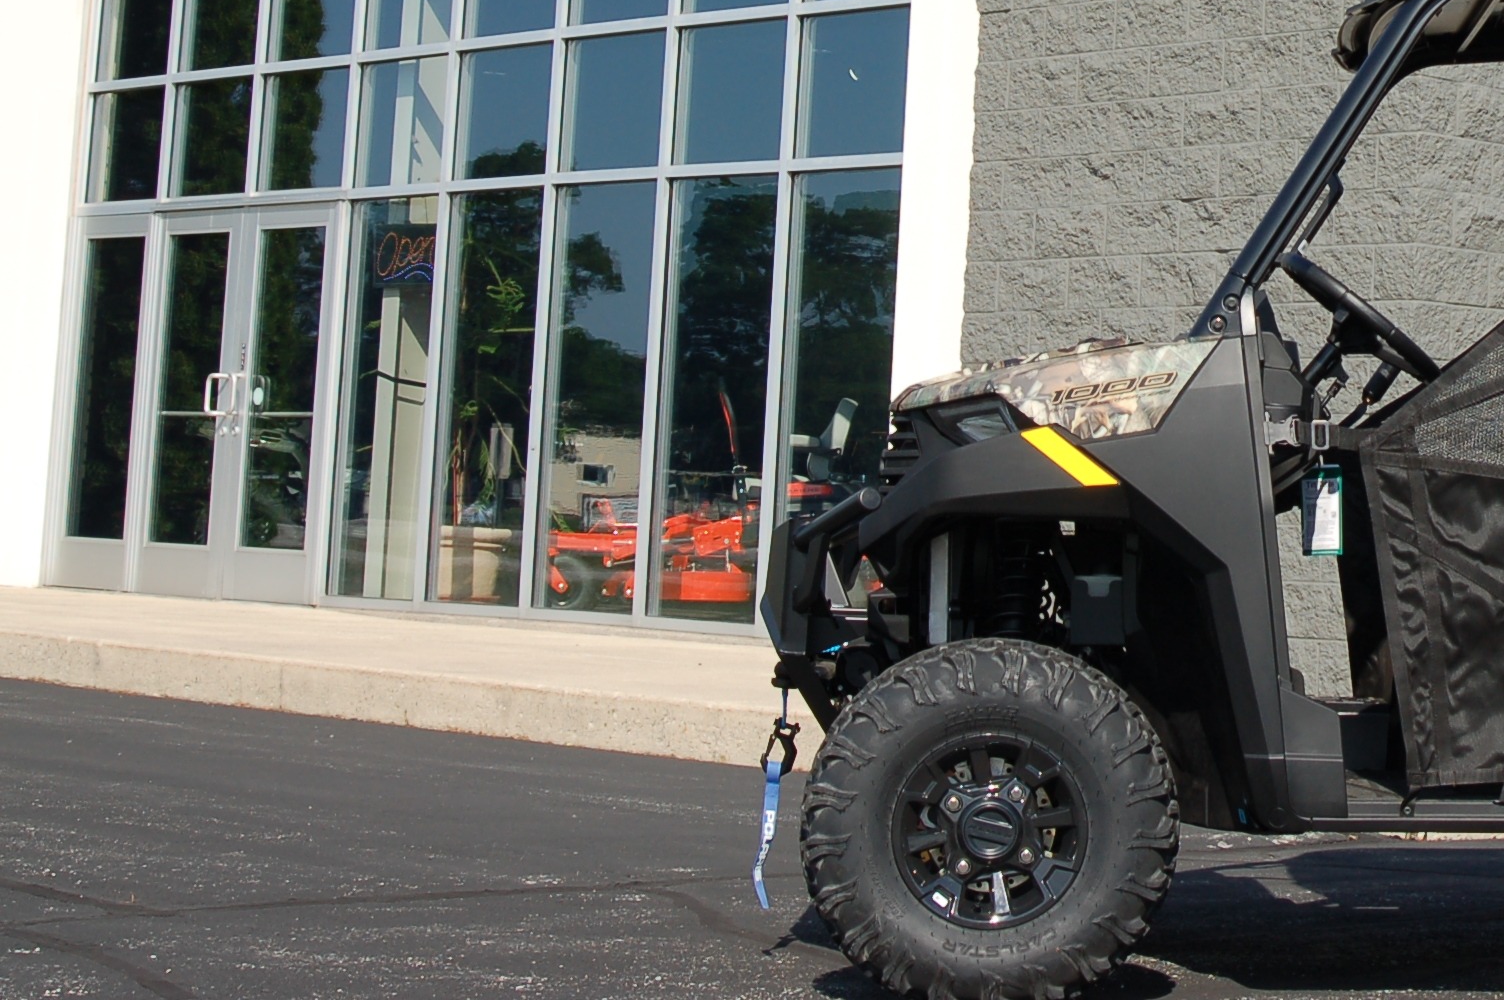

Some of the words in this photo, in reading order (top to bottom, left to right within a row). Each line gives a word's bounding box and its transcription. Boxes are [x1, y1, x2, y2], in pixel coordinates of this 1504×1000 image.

[376, 231, 436, 276] Open
[1051, 370, 1178, 405] 1000
[754, 809, 777, 882] POLARIS
[942, 927, 1057, 958] CARLSTAR
